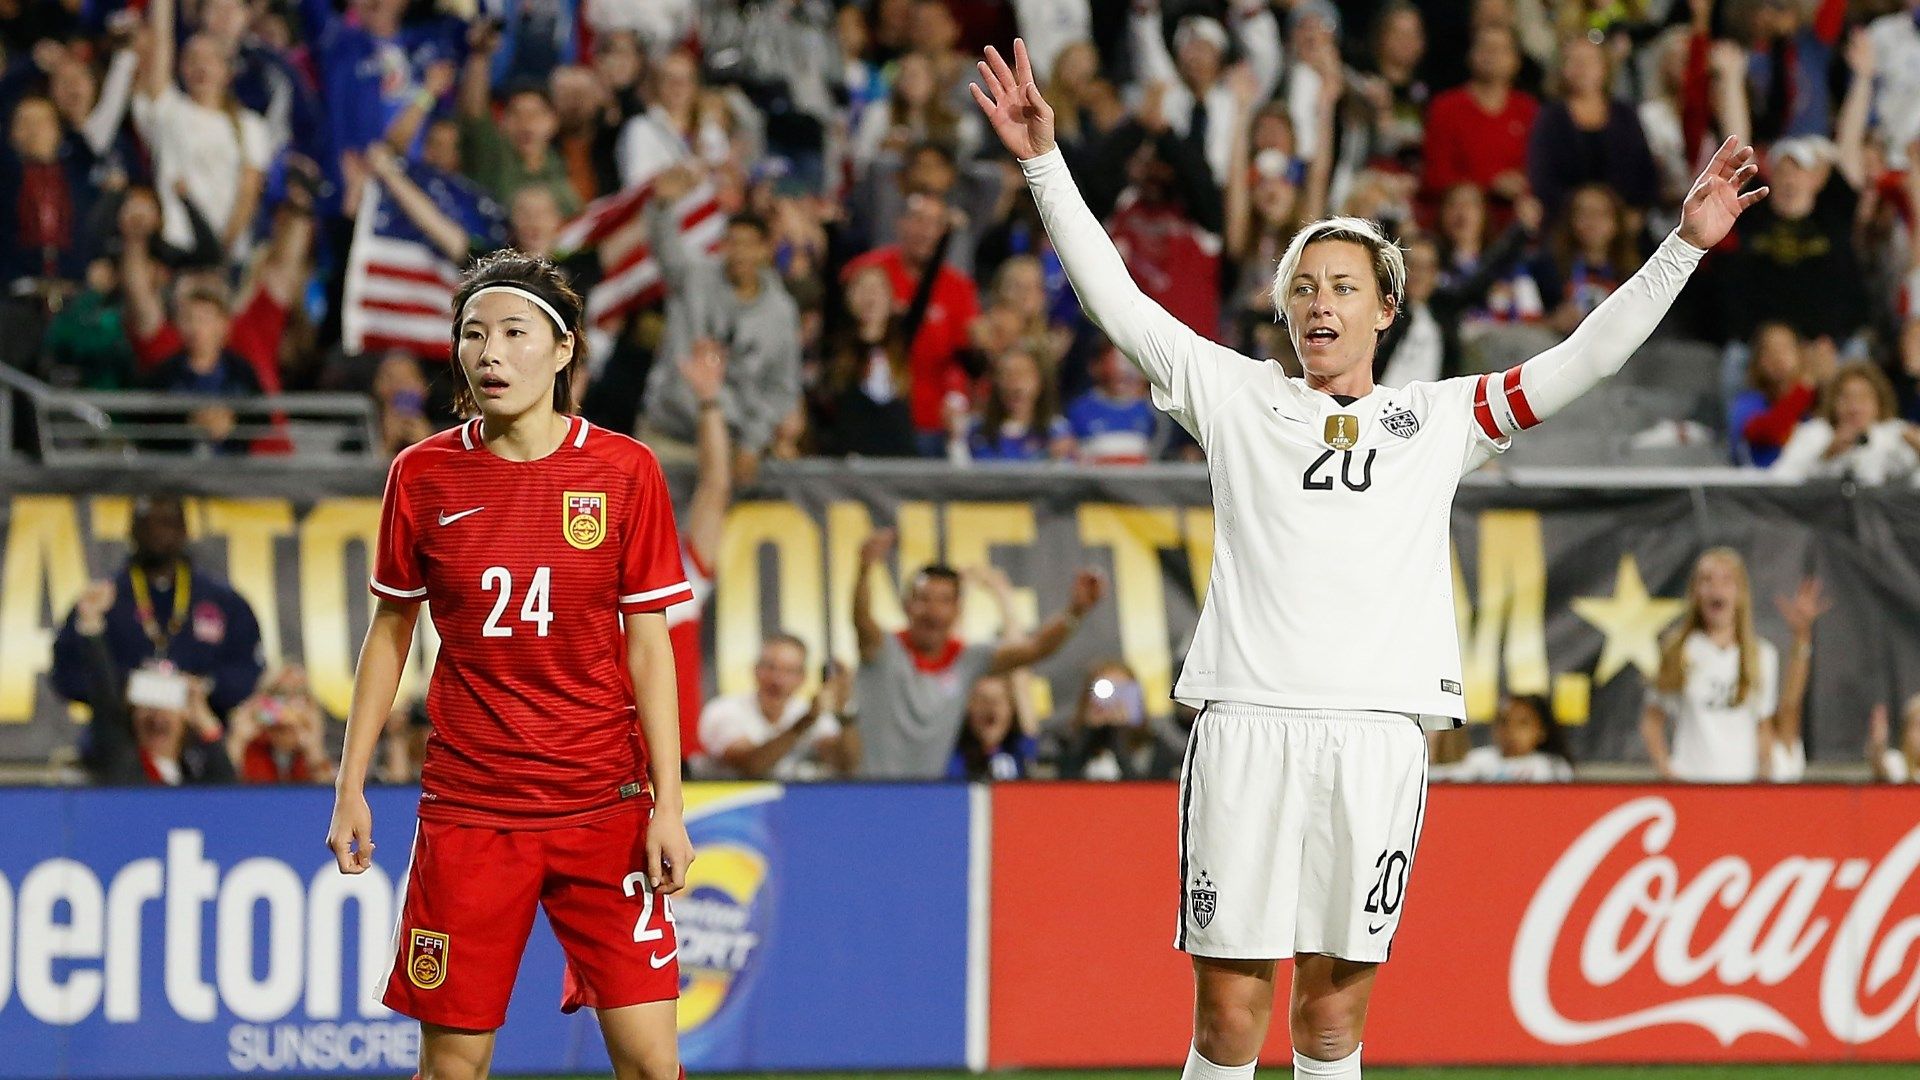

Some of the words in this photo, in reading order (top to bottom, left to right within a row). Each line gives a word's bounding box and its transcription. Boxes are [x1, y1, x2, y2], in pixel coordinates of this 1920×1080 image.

[1303, 448, 1376, 492] 20
[569, 497, 600, 508] CFA
[481, 566, 554, 637] 24
[1363, 848, 1407, 915] 20
[0, 828, 408, 1025] erton
[415, 935, 443, 950] CFA
